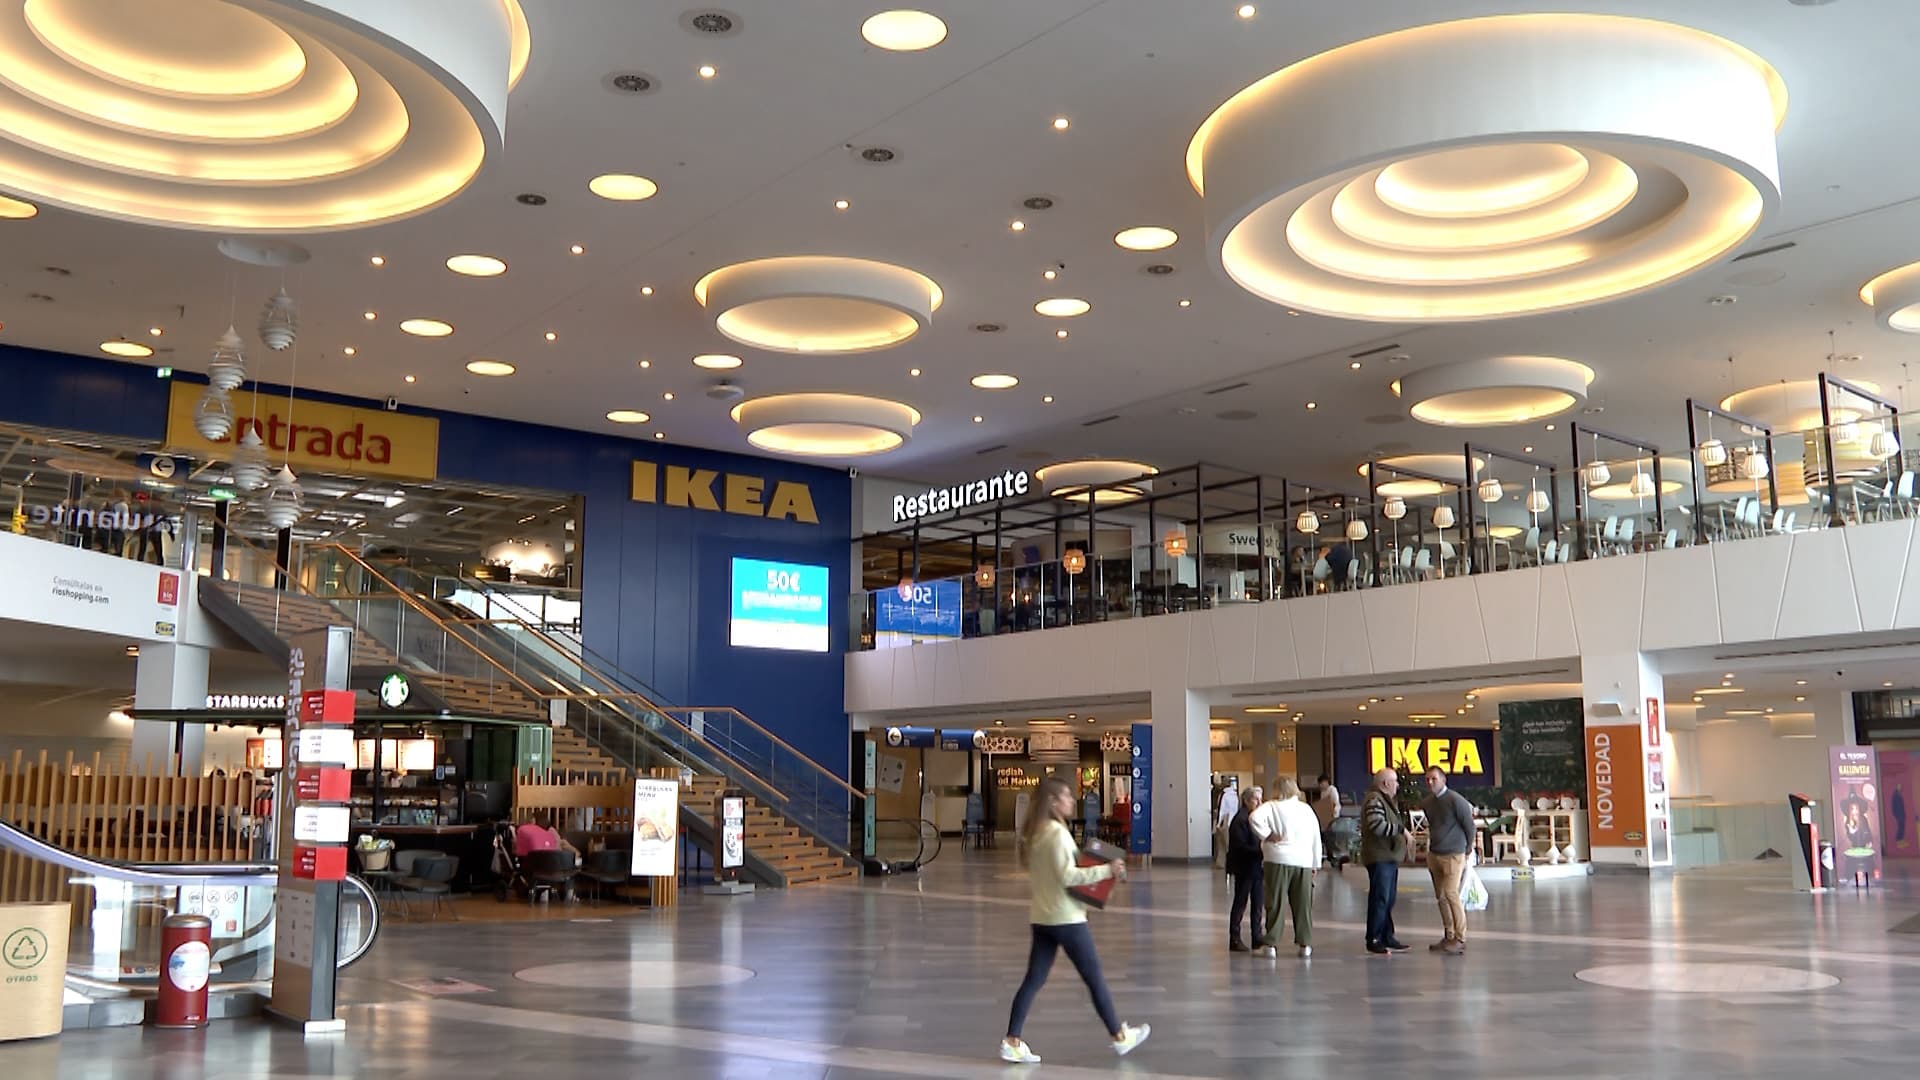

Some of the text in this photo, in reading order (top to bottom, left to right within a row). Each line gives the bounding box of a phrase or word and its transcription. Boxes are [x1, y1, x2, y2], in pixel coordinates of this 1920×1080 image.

[212, 413, 392, 464] ntrada
[632, 460, 820, 524] IKEA
[892, 470, 1029, 522] Restaurante
[52, 587, 109, 604] rioshopping.com
[767, 569, 801, 592] 50€
[205, 694, 285, 709] STARBUCKS
[1371, 737, 1484, 775] IKEA
[1011, 776, 1040, 786] Market
[1594, 732, 1614, 830] NOVEDAD
[6, 975, 38, 983] OTROS
